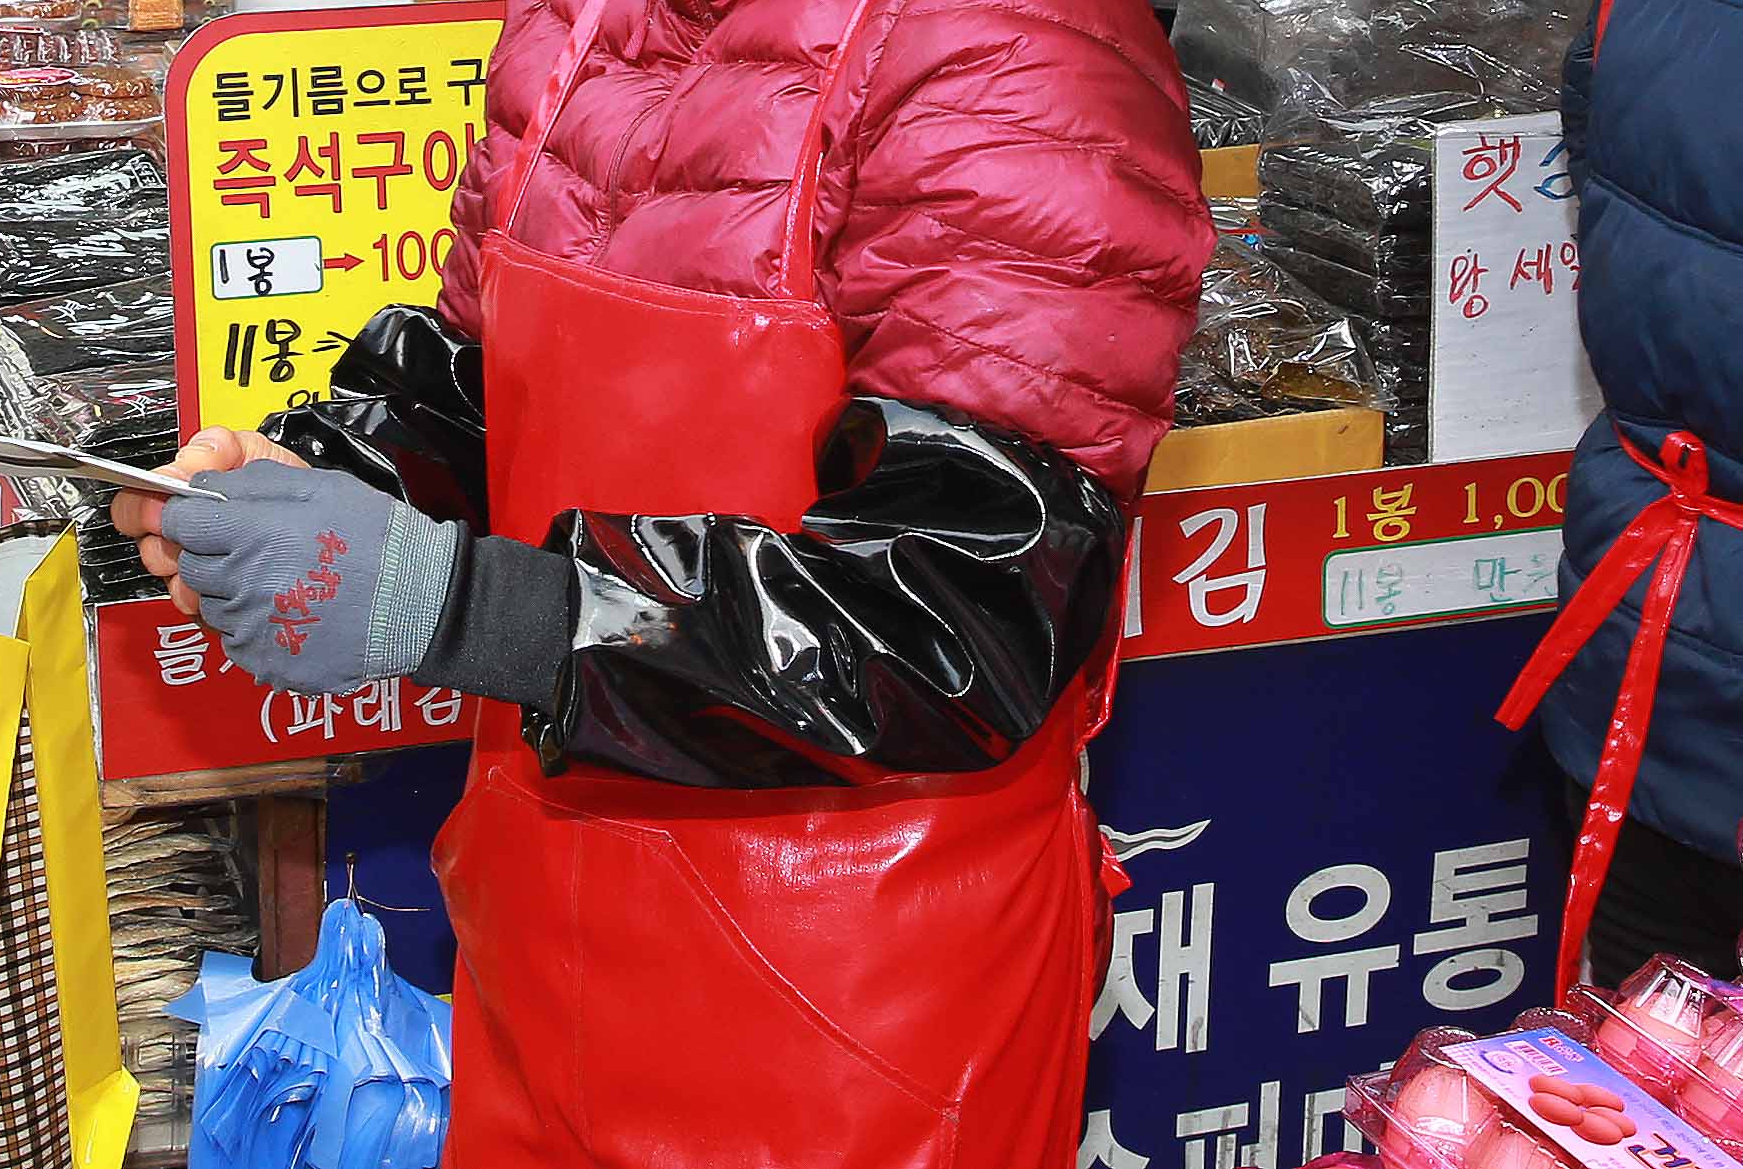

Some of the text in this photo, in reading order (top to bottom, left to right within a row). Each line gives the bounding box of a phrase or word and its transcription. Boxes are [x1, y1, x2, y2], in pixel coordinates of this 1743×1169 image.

[212, 65, 433, 121] 들기름으로
[212, 122, 477, 219] 즉석구이
[1268, 837, 1540, 1035] 유통
